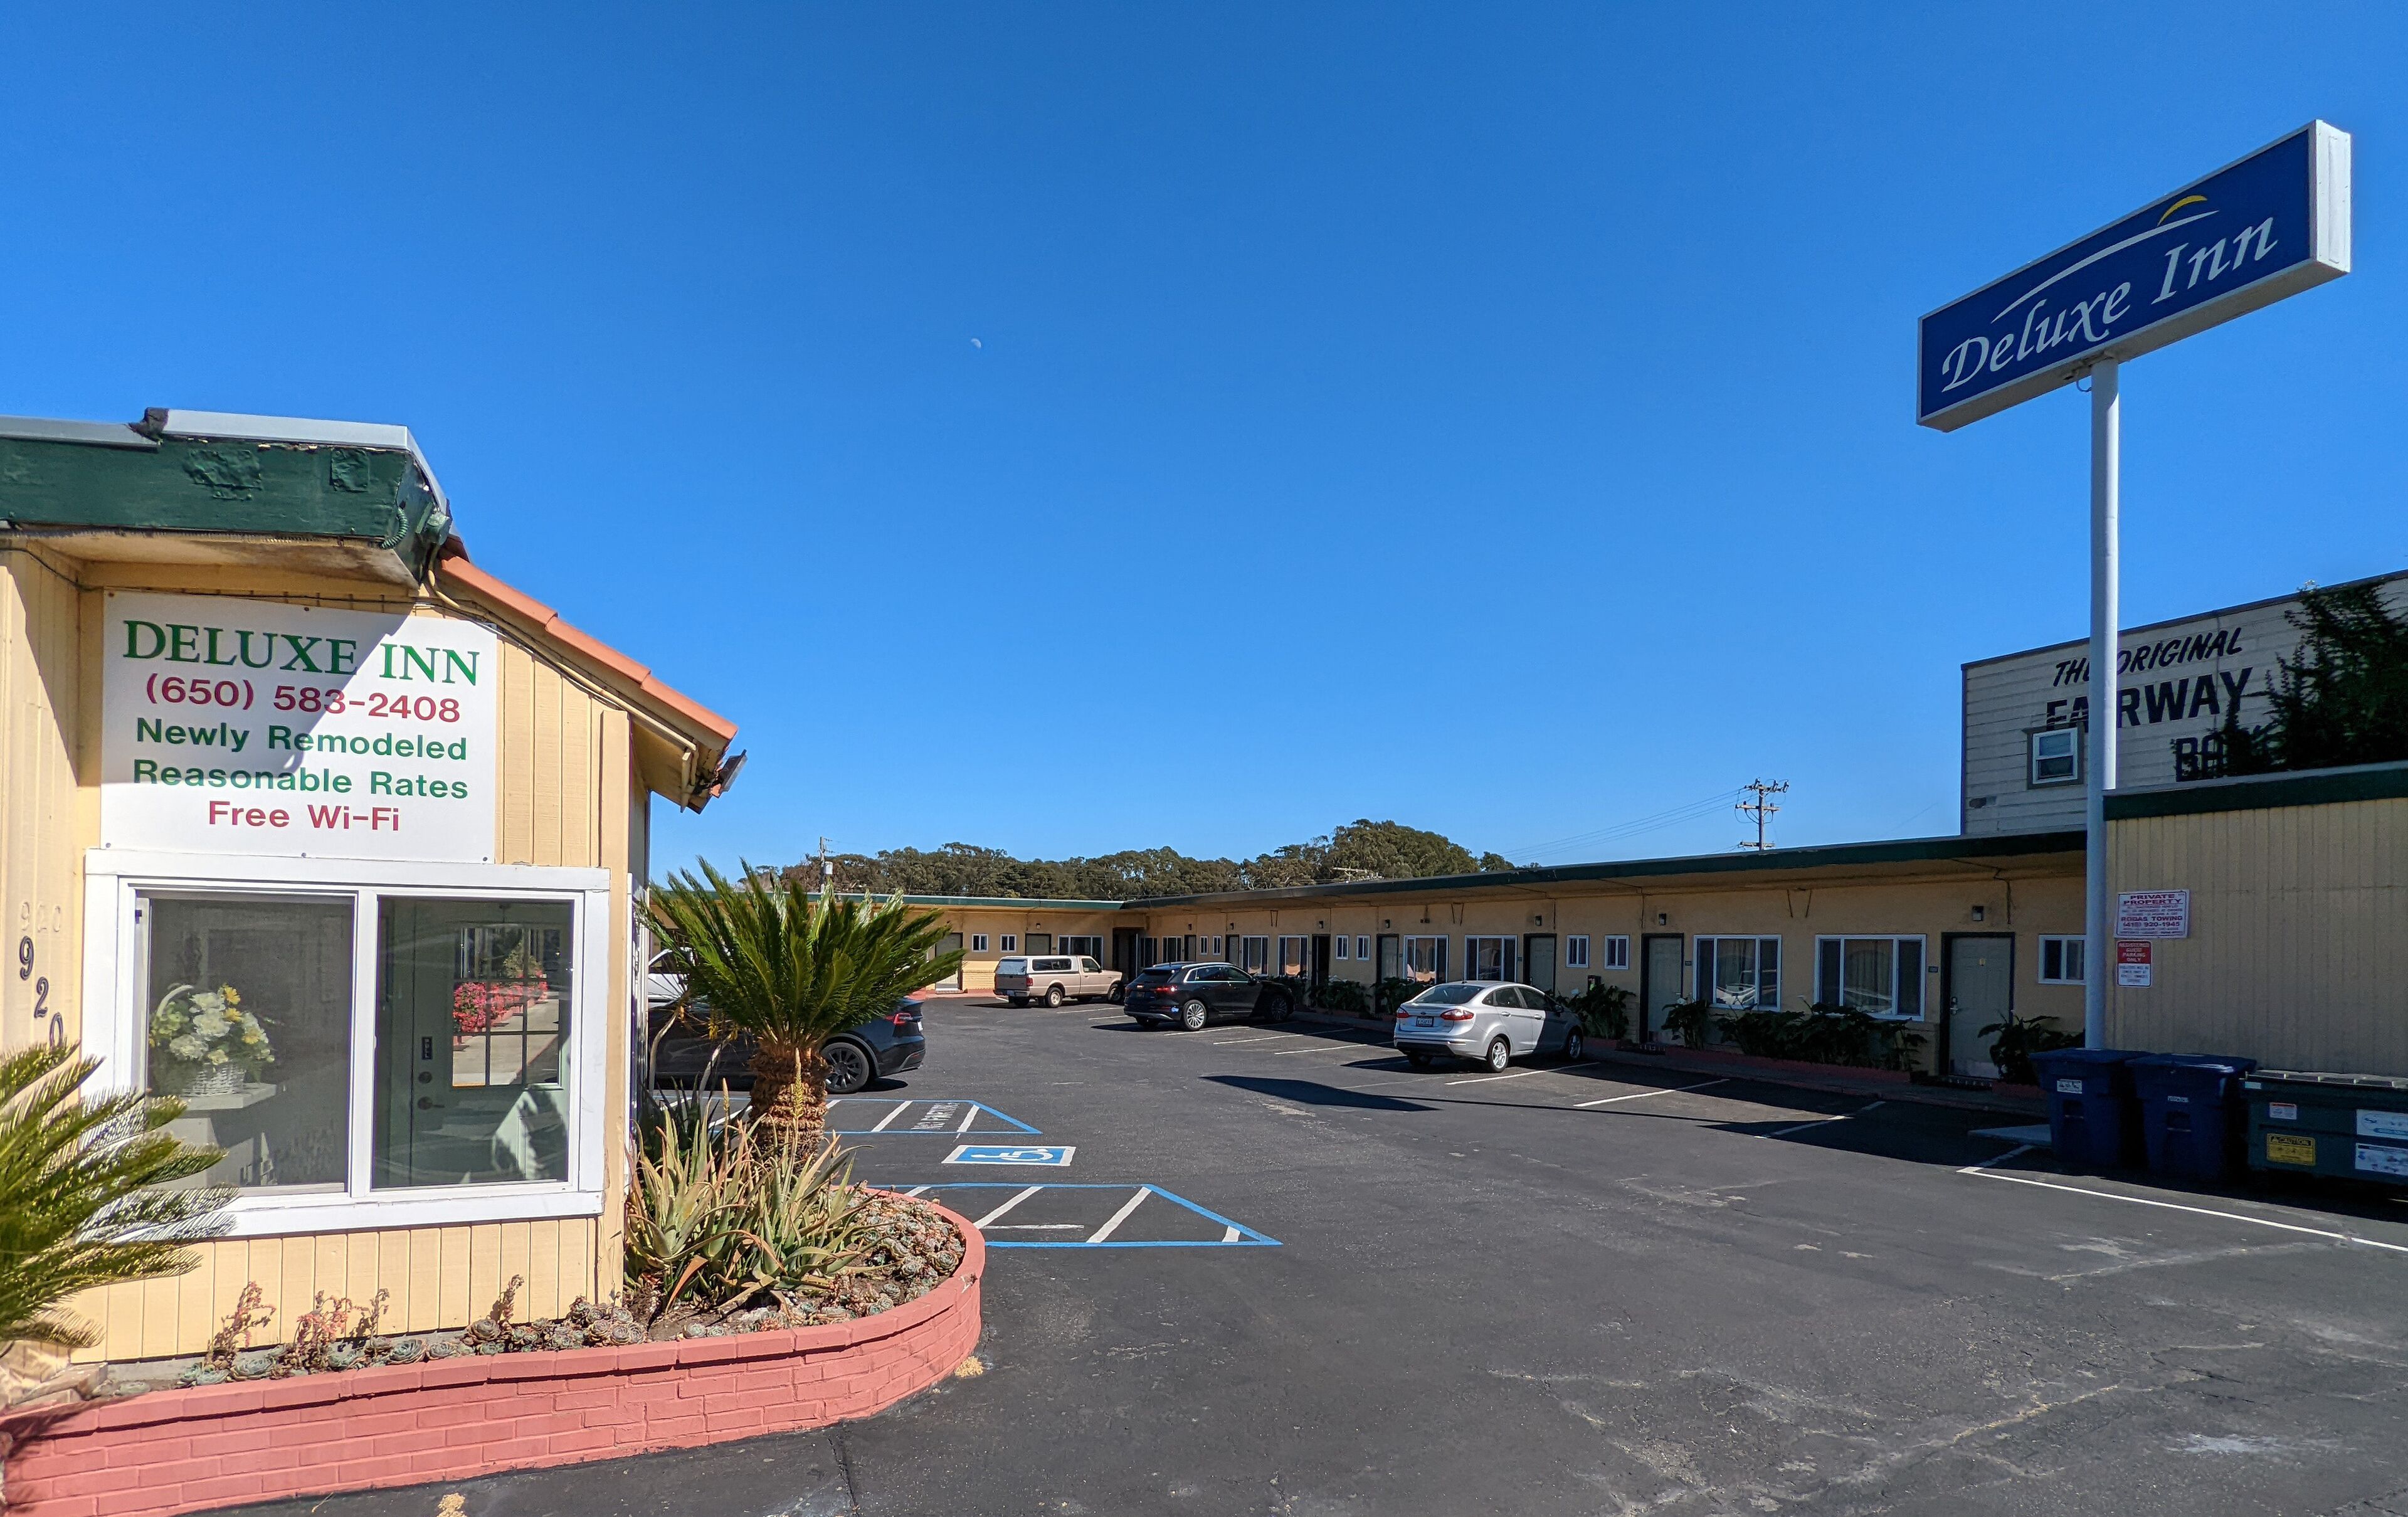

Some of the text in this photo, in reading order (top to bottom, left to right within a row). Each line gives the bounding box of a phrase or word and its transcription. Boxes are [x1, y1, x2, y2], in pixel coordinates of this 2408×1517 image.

[1941, 217, 2278, 392] Deluxe Inn
[124, 620, 479, 686] DELUXE INN
[147, 673, 460, 722] (650) 583-2408
[2046, 667, 2253, 732] FARWAY
[136, 718, 467, 761] Newly Remodeled
[134, 759, 468, 799] Reasonable Rates
[209, 801, 400, 831] Free Wi-Fi
